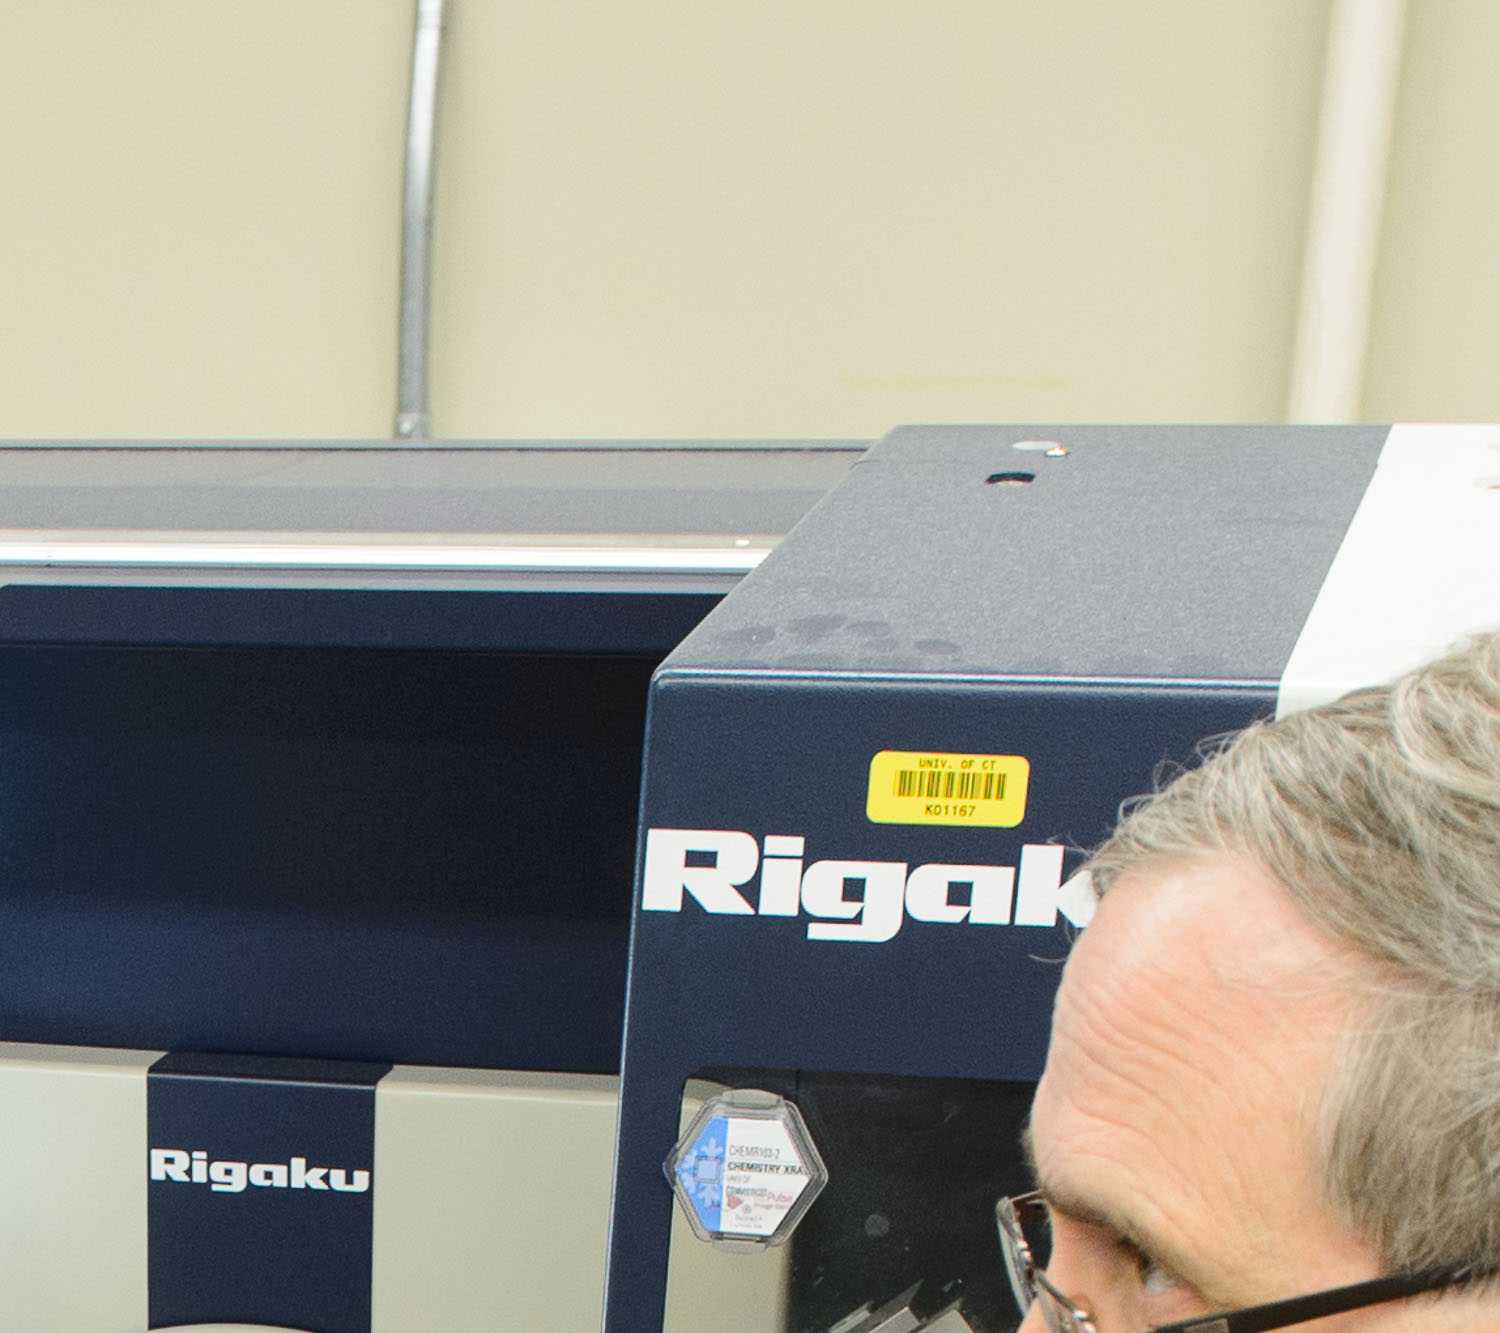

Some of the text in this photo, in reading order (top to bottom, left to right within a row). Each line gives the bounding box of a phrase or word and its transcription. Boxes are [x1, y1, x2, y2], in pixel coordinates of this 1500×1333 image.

[918, 757, 997, 771] UNIV. OF CT
[640, 826, 1100, 945] Rigak
[149, 1147, 371, 1194] Rigaku
[727, 1161, 808, 1176] CHEMISTRY XRA
